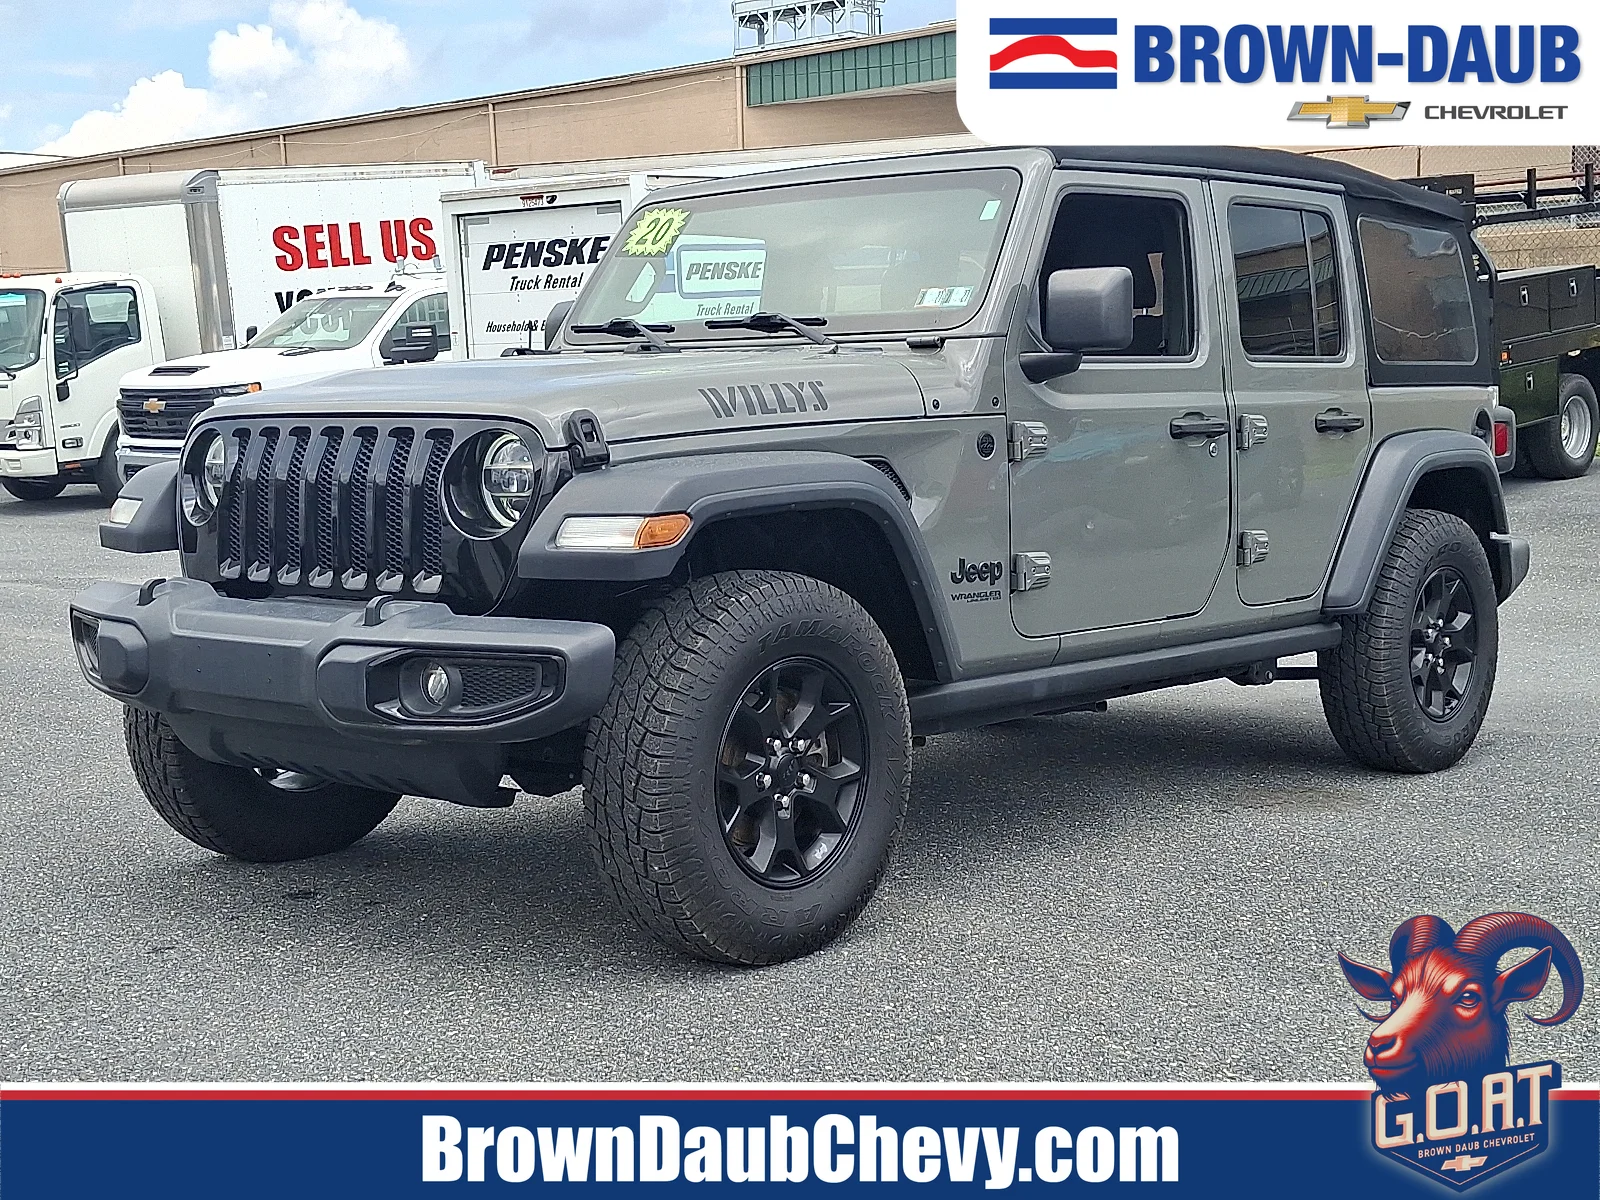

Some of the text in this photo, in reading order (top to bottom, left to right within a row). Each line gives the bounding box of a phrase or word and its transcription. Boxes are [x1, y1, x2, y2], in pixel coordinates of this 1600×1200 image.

[272, 217, 437, 272] SELL US
[638, 217, 676, 246] 20
[482, 236, 610, 272] PENSKE
[509, 273, 584, 292] Truck Rental
[685, 260, 764, 281] PENSKE
[696, 301, 755, 317] Truck Rental
[698, 380, 829, 418] WILLYS
[951, 558, 1002, 585] Jeep
[950, 590, 1002, 601] WRANGLER
